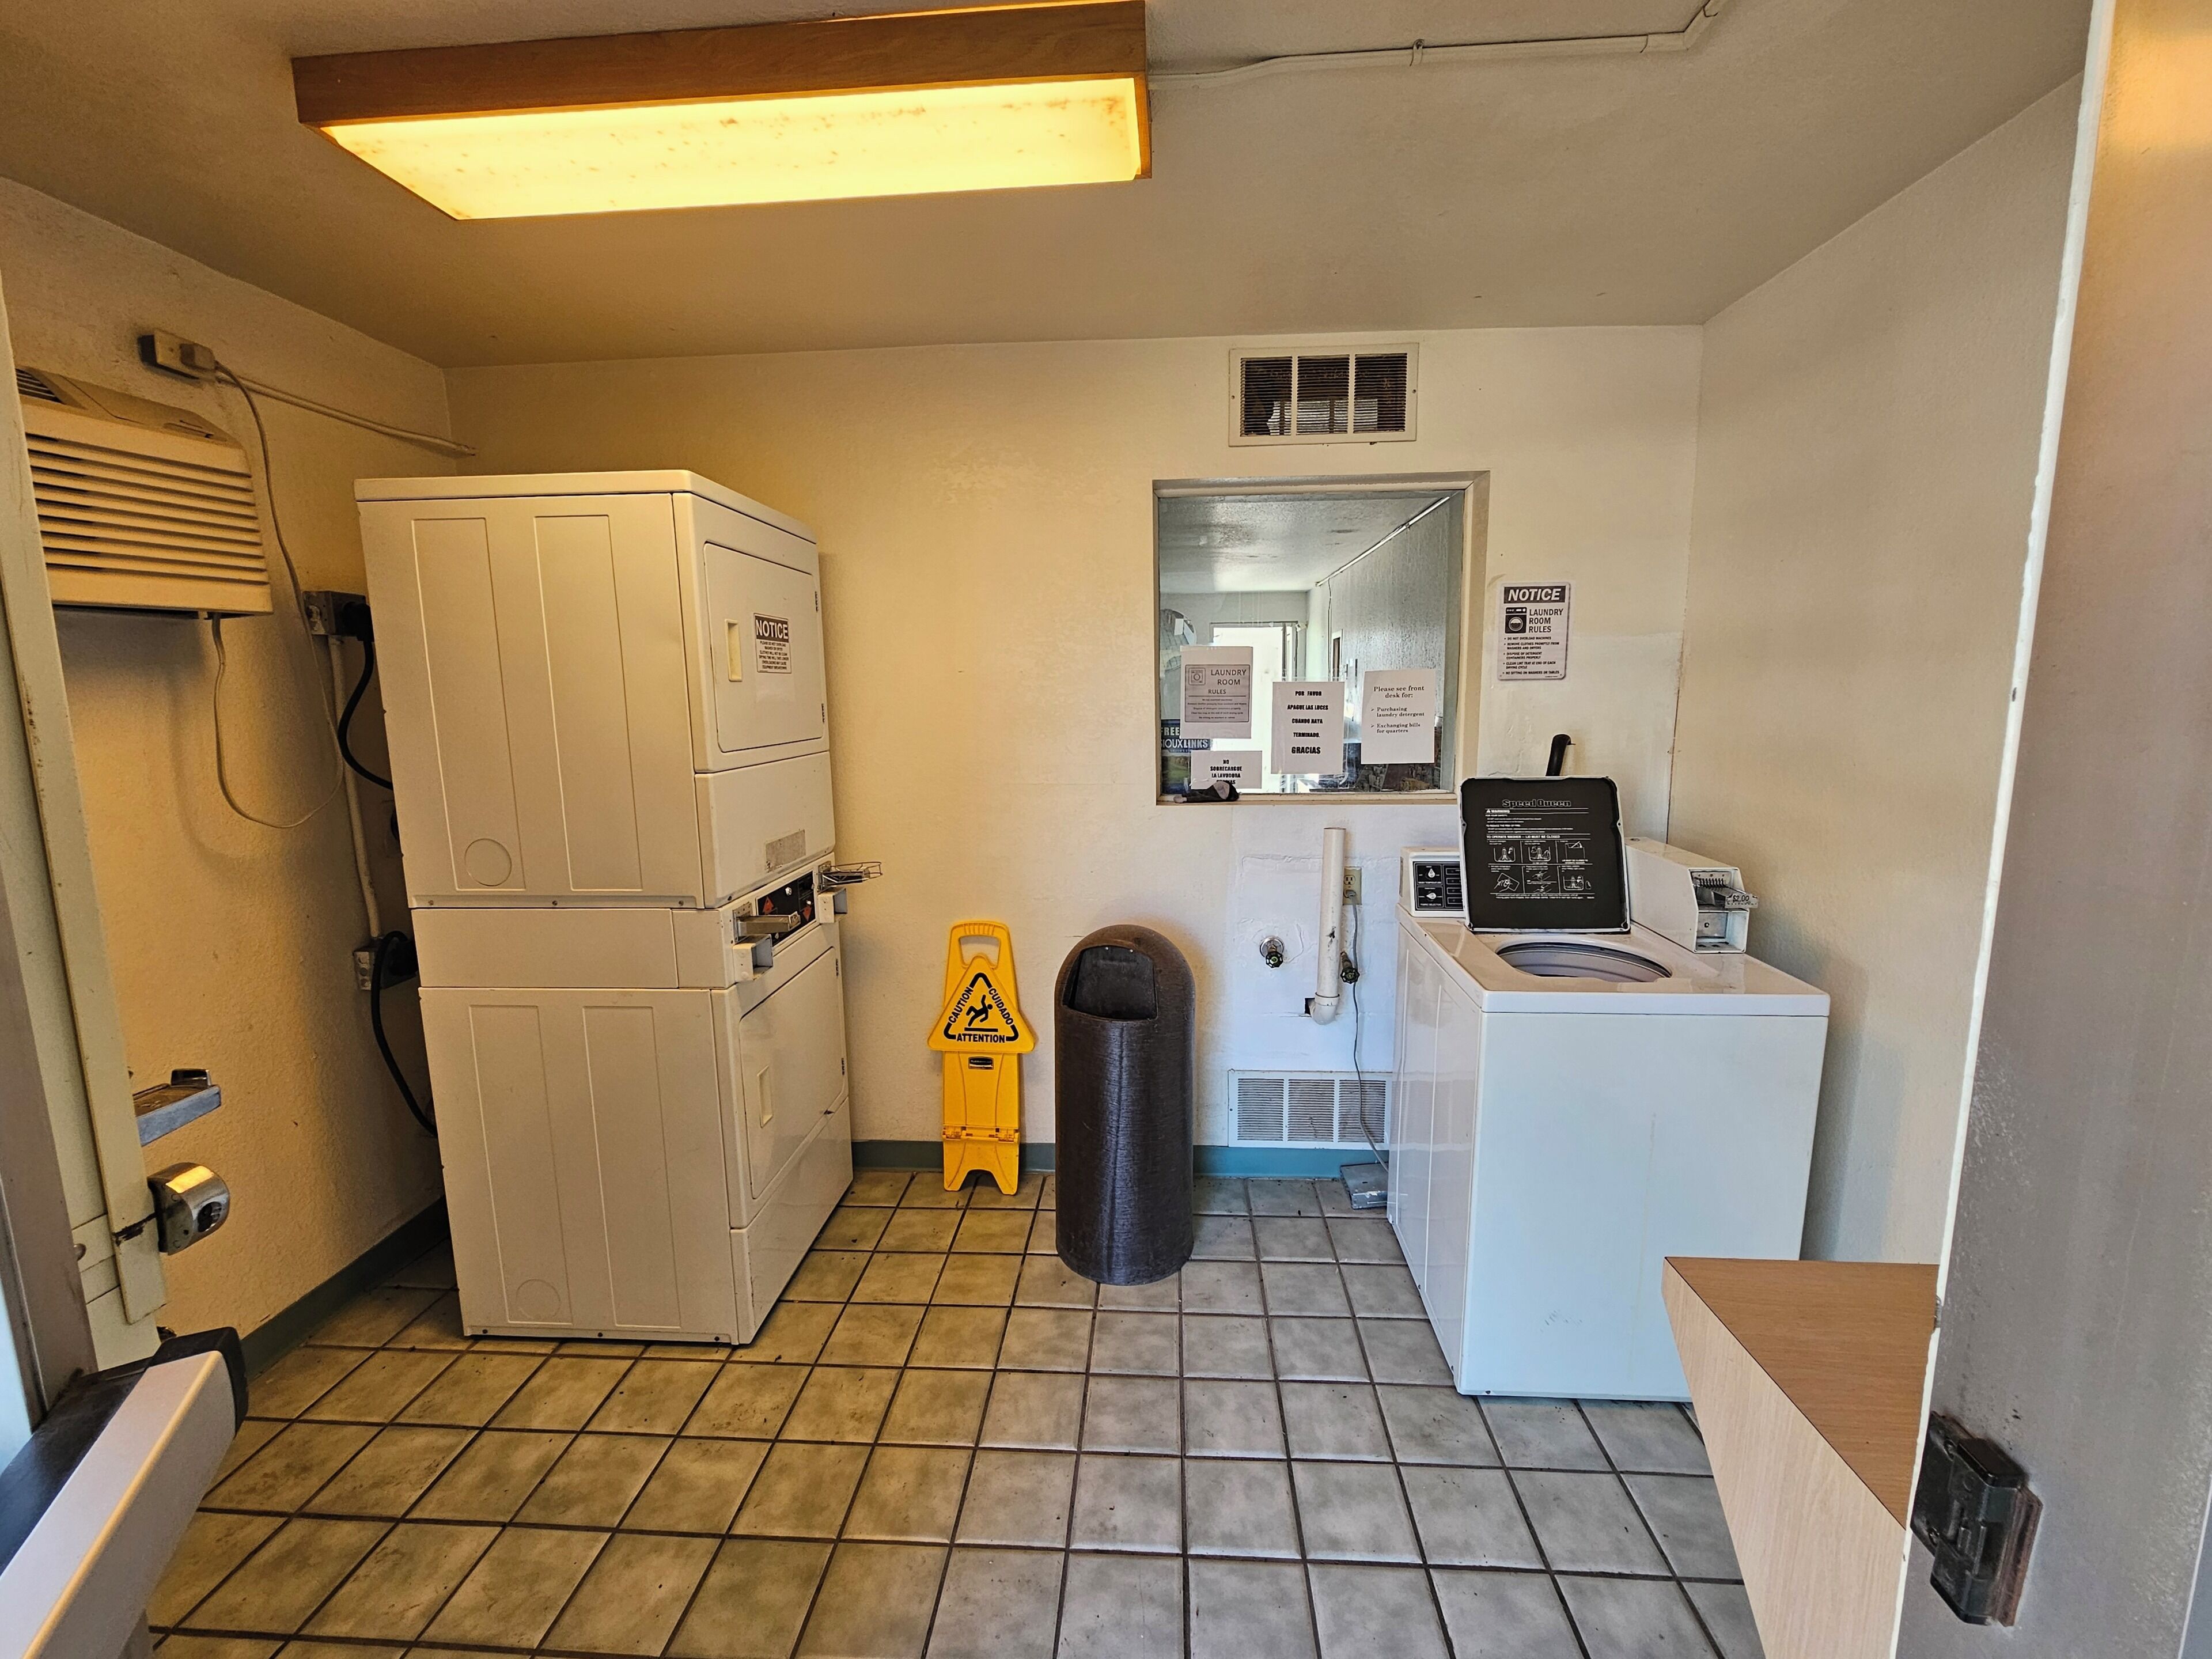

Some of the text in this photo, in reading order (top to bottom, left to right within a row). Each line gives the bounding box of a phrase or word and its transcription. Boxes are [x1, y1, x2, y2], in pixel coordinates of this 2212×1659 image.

[1508, 588, 1561, 601] NOTICE
[756, 619, 788, 639] NOTICE
[1502, 798, 1571, 809] Speed Queen
[948, 987, 974, 1023] CAUTION
[988, 988, 1014, 1025] CUIDADO
[957, 1033, 1005, 1043] ATTENTION
